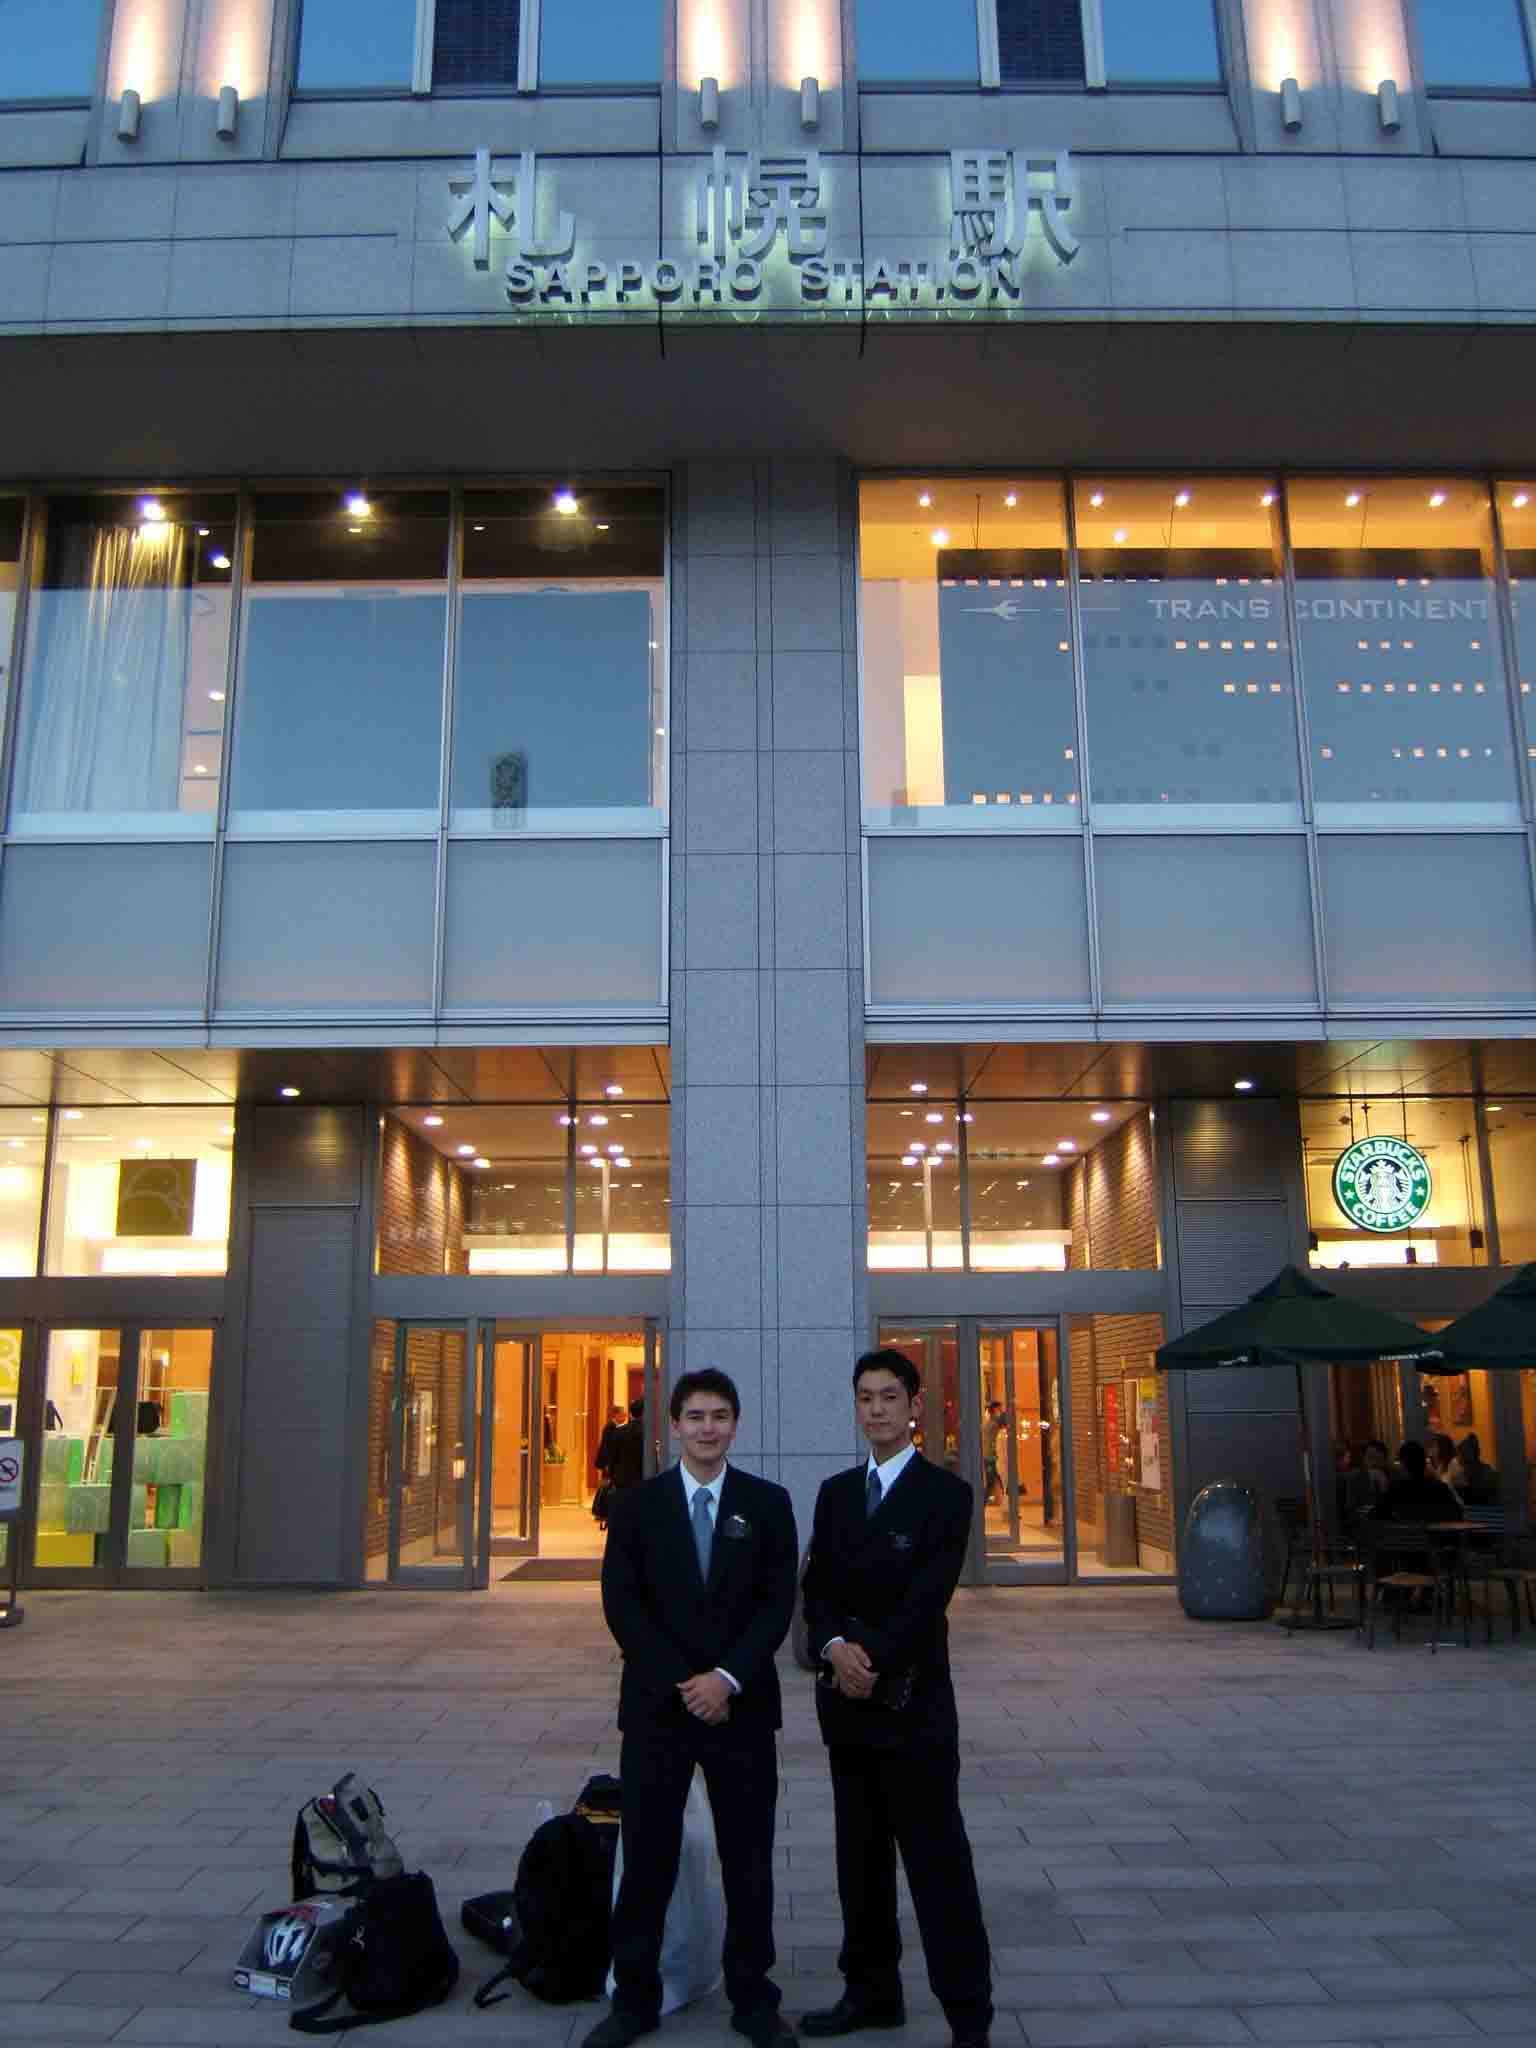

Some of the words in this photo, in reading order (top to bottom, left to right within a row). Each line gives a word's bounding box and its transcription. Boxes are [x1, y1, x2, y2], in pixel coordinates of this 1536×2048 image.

[447, 146, 1083, 271] 札幌駅
[505, 256, 762, 305] SAPPORO
[801, 256, 1022, 303] STATION
[1149, 599, 1272, 621] TRANS
[1340, 1140, 1426, 1184] STARBUCKS
[1351, 1202, 1420, 1228] COFFEE
